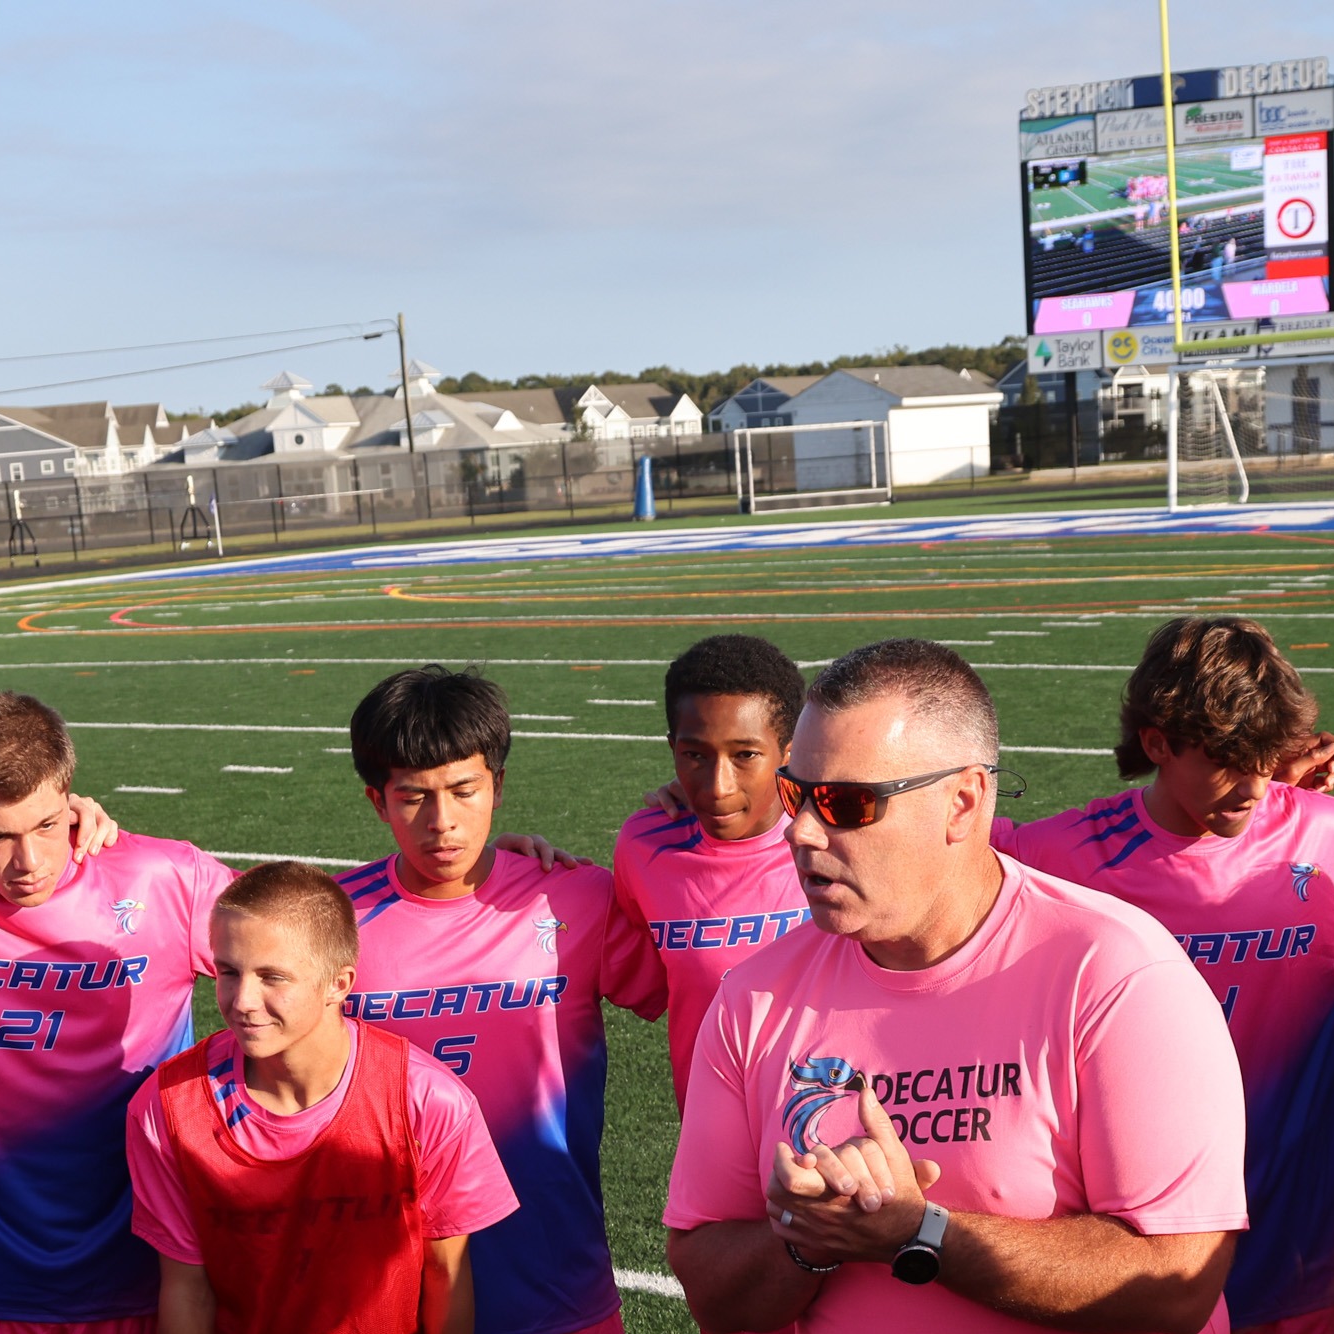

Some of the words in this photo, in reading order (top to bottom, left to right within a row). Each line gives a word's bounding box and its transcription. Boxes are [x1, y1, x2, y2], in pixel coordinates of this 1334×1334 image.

[1026, 78, 1135, 119] STEPHEN
[1223, 55, 1329, 98] DECATUR
[1184, 110, 1244, 125] PRESTON
[1036, 130, 1094, 147] ATLANTIC
[1100, 133, 1164, 149] JEWELER
[1047, 142, 1093, 157] GENERAL
[1060, 294, 1114, 310] SEAHAWKS
[1269, 299, 1281, 316] 0
[1082, 310, 1093, 327] 0
[1055, 337, 1096, 354] Taylor
[1057, 353, 1091, 368] Bank
[648, 906, 813, 951] DECAT
[871, 1062, 1022, 1106] DECATUR
[888, 1107, 993, 1145] OCCER
